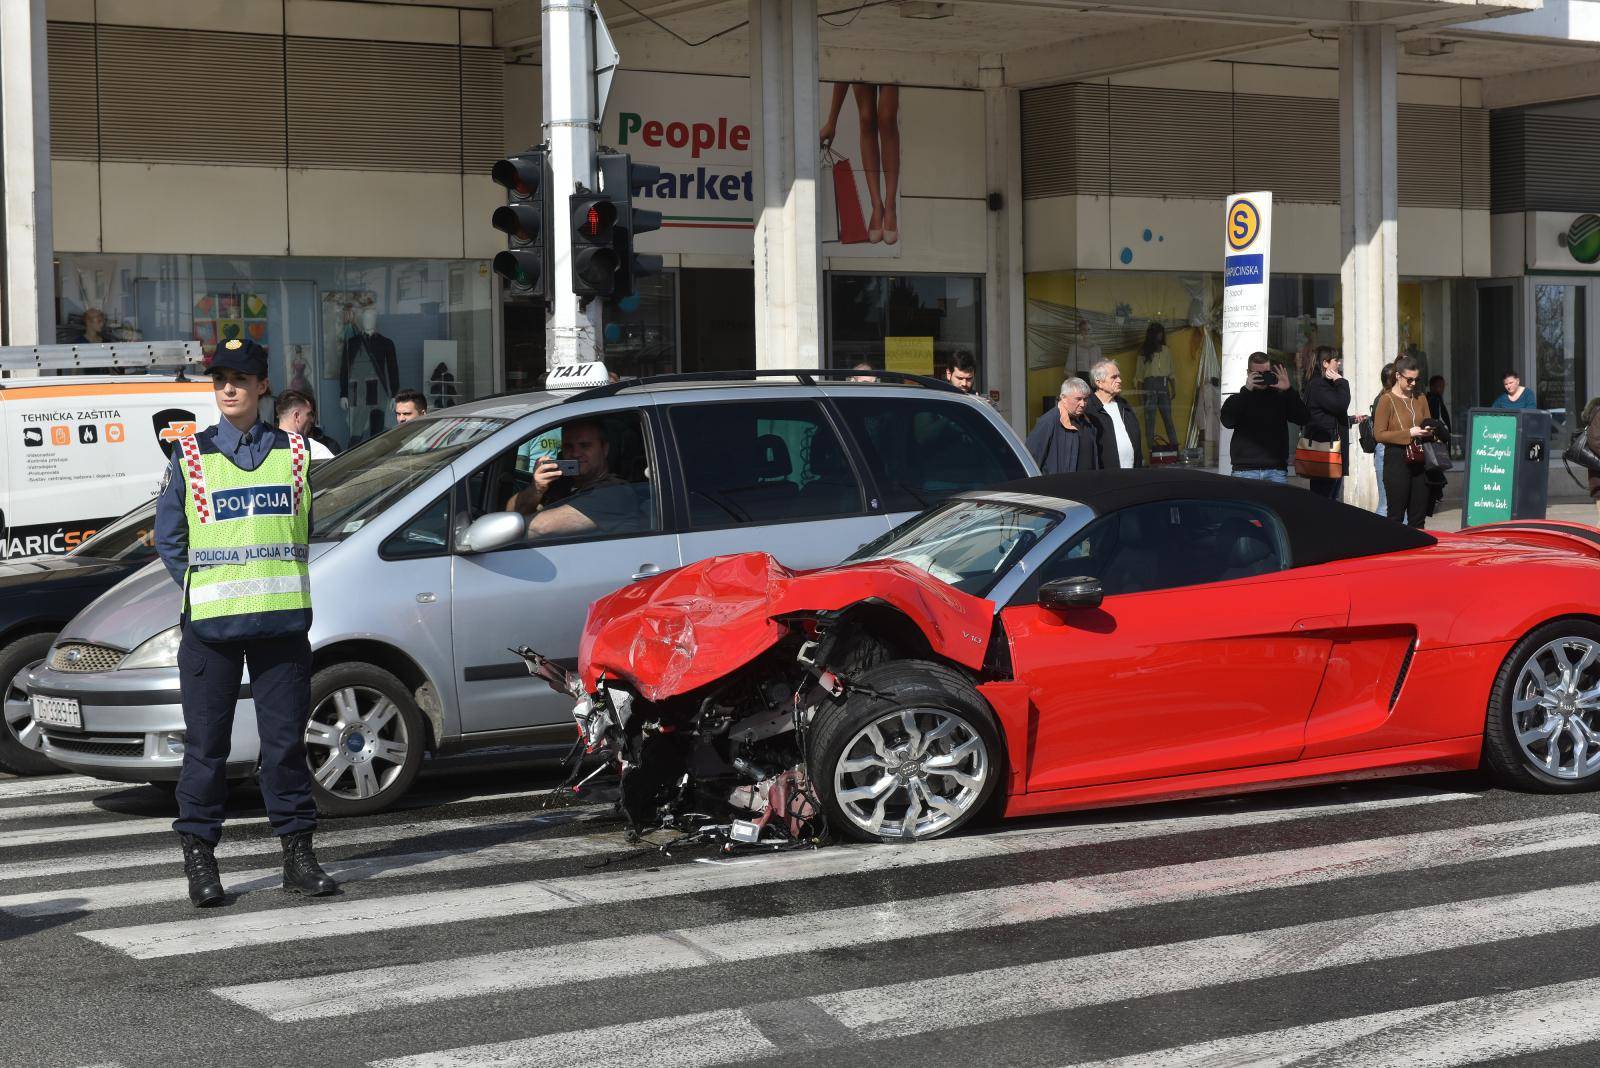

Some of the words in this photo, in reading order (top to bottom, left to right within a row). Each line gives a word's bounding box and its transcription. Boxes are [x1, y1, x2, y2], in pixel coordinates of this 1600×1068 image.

[618, 112, 750, 158] People
[1233, 210, 1249, 239] S
[553, 364, 593, 378] TAXI
[20, 410, 74, 422] TEHNIČKA
[76, 409, 121, 420] ZAŠTITA
[216, 492, 289, 513] POLICIJA
[195, 550, 240, 562] POLICIJA
